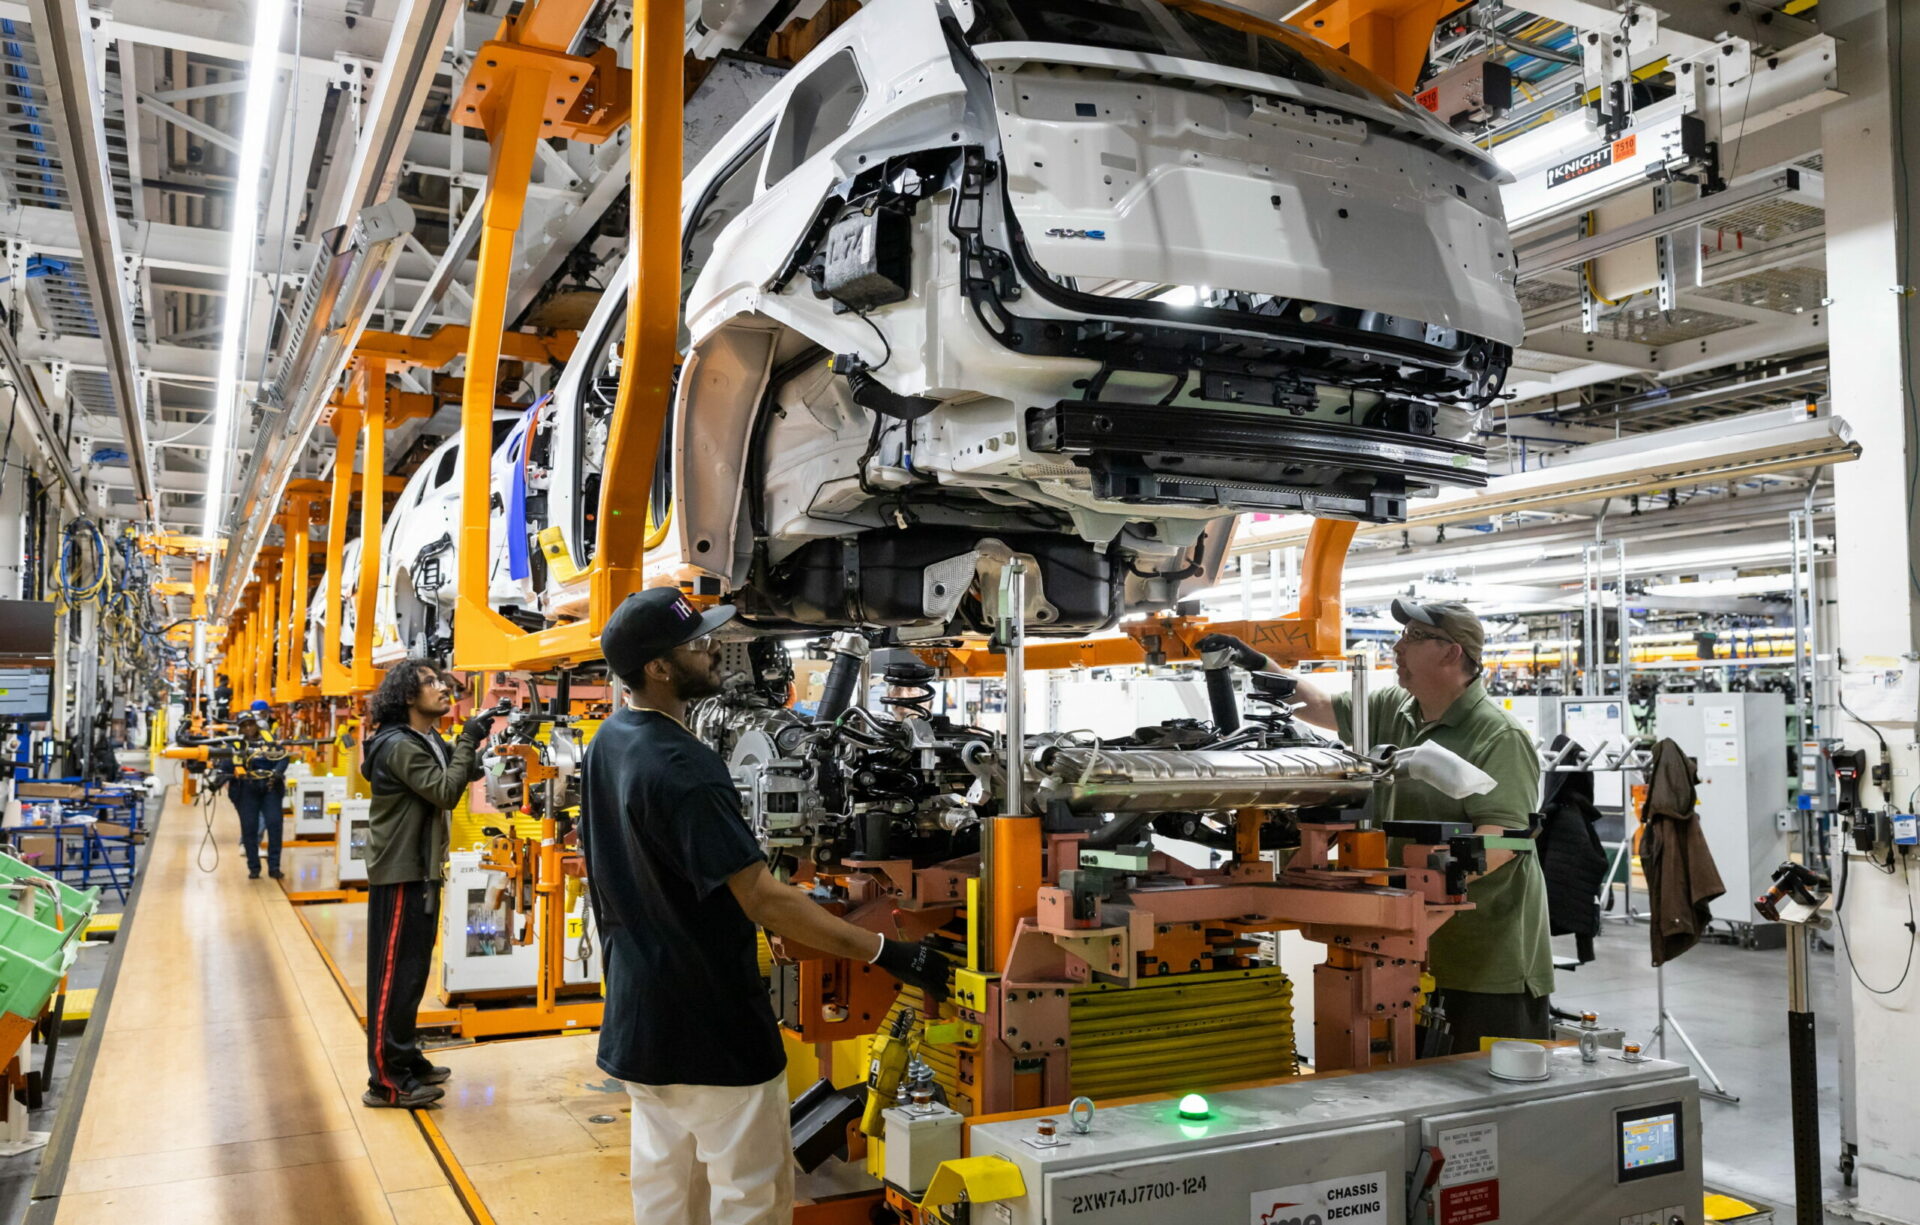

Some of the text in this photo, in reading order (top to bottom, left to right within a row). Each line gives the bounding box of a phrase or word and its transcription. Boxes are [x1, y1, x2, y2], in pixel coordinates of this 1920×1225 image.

[1616, 139, 1634, 152] 7510
[1555, 147, 1611, 178] KNIGHT
[1073, 1176, 1206, 1214] 2XW74J7700-124
[1327, 1182, 1378, 1201] CHASSIS
[1327, 1201, 1380, 1220] DECKING
